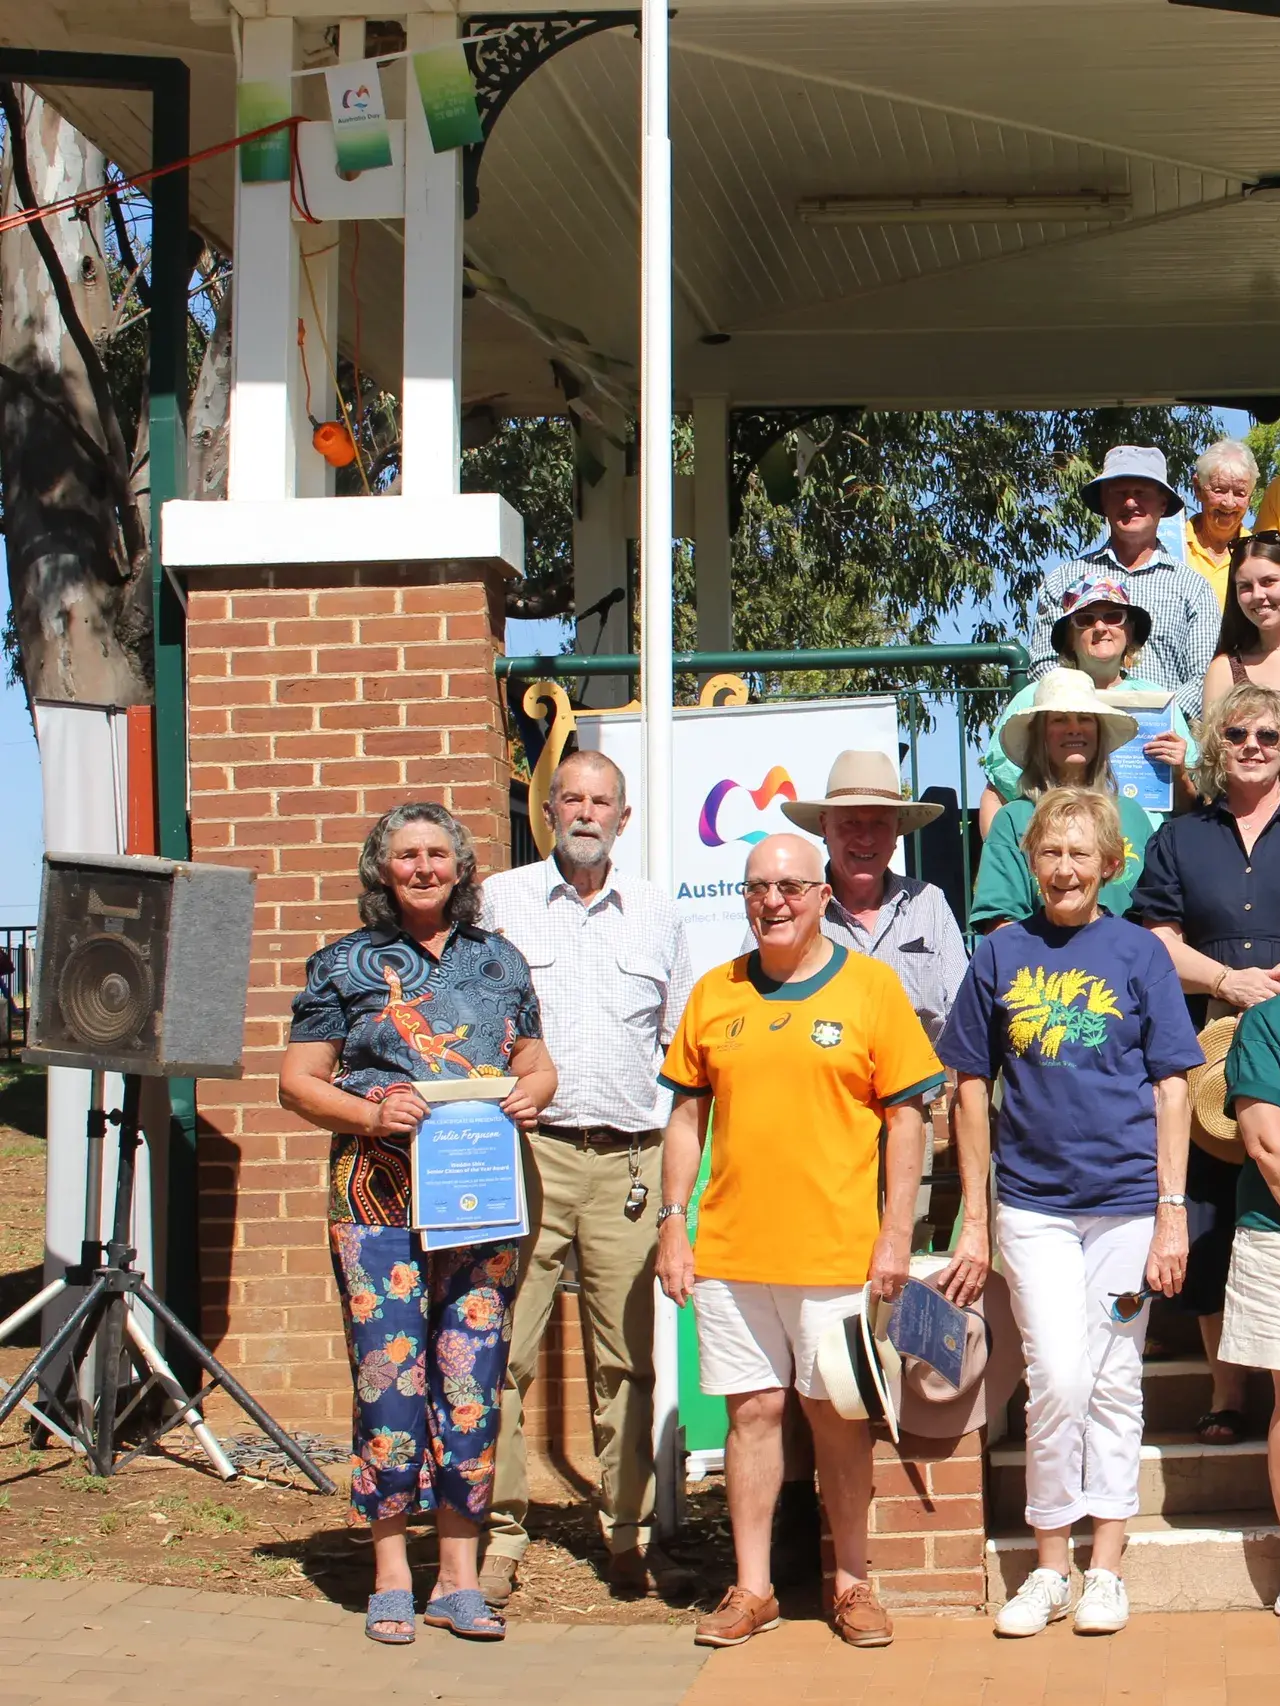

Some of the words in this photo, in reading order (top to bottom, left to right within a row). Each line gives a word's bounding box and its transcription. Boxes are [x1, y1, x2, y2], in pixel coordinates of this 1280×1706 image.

[337, 115, 366, 124] Australia
[368, 112, 381, 121] Day
[677, 879, 744, 900] Austra
[684, 913, 720, 924] eflect.
[722, 911, 746, 923] Resp
[433, 1129, 459, 1142] Julie
[461, 1128, 501, 1145] Ferguson
